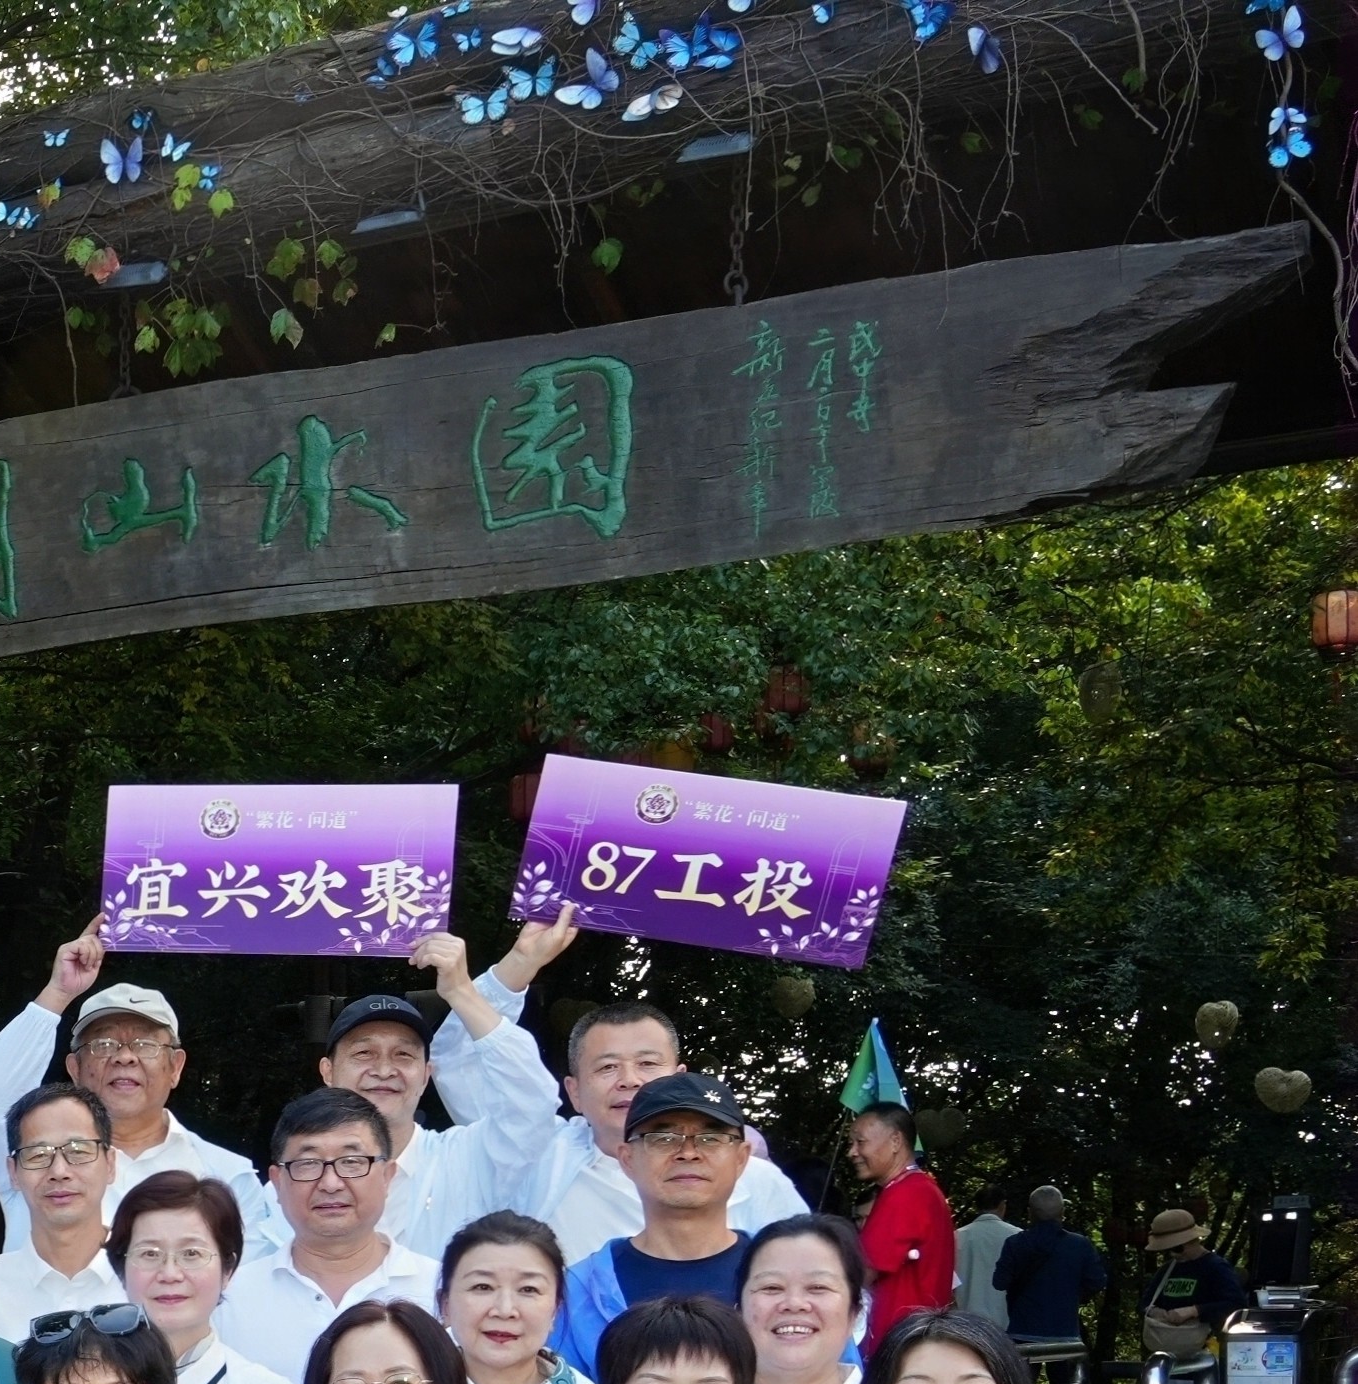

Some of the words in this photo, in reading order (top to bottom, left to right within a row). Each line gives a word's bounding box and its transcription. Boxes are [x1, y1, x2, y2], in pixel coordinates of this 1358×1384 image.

[122, 857, 432, 926] 宜兴欢聚
[581, 841, 814, 920] 87工投
[369, 998, 399, 1010] alo
